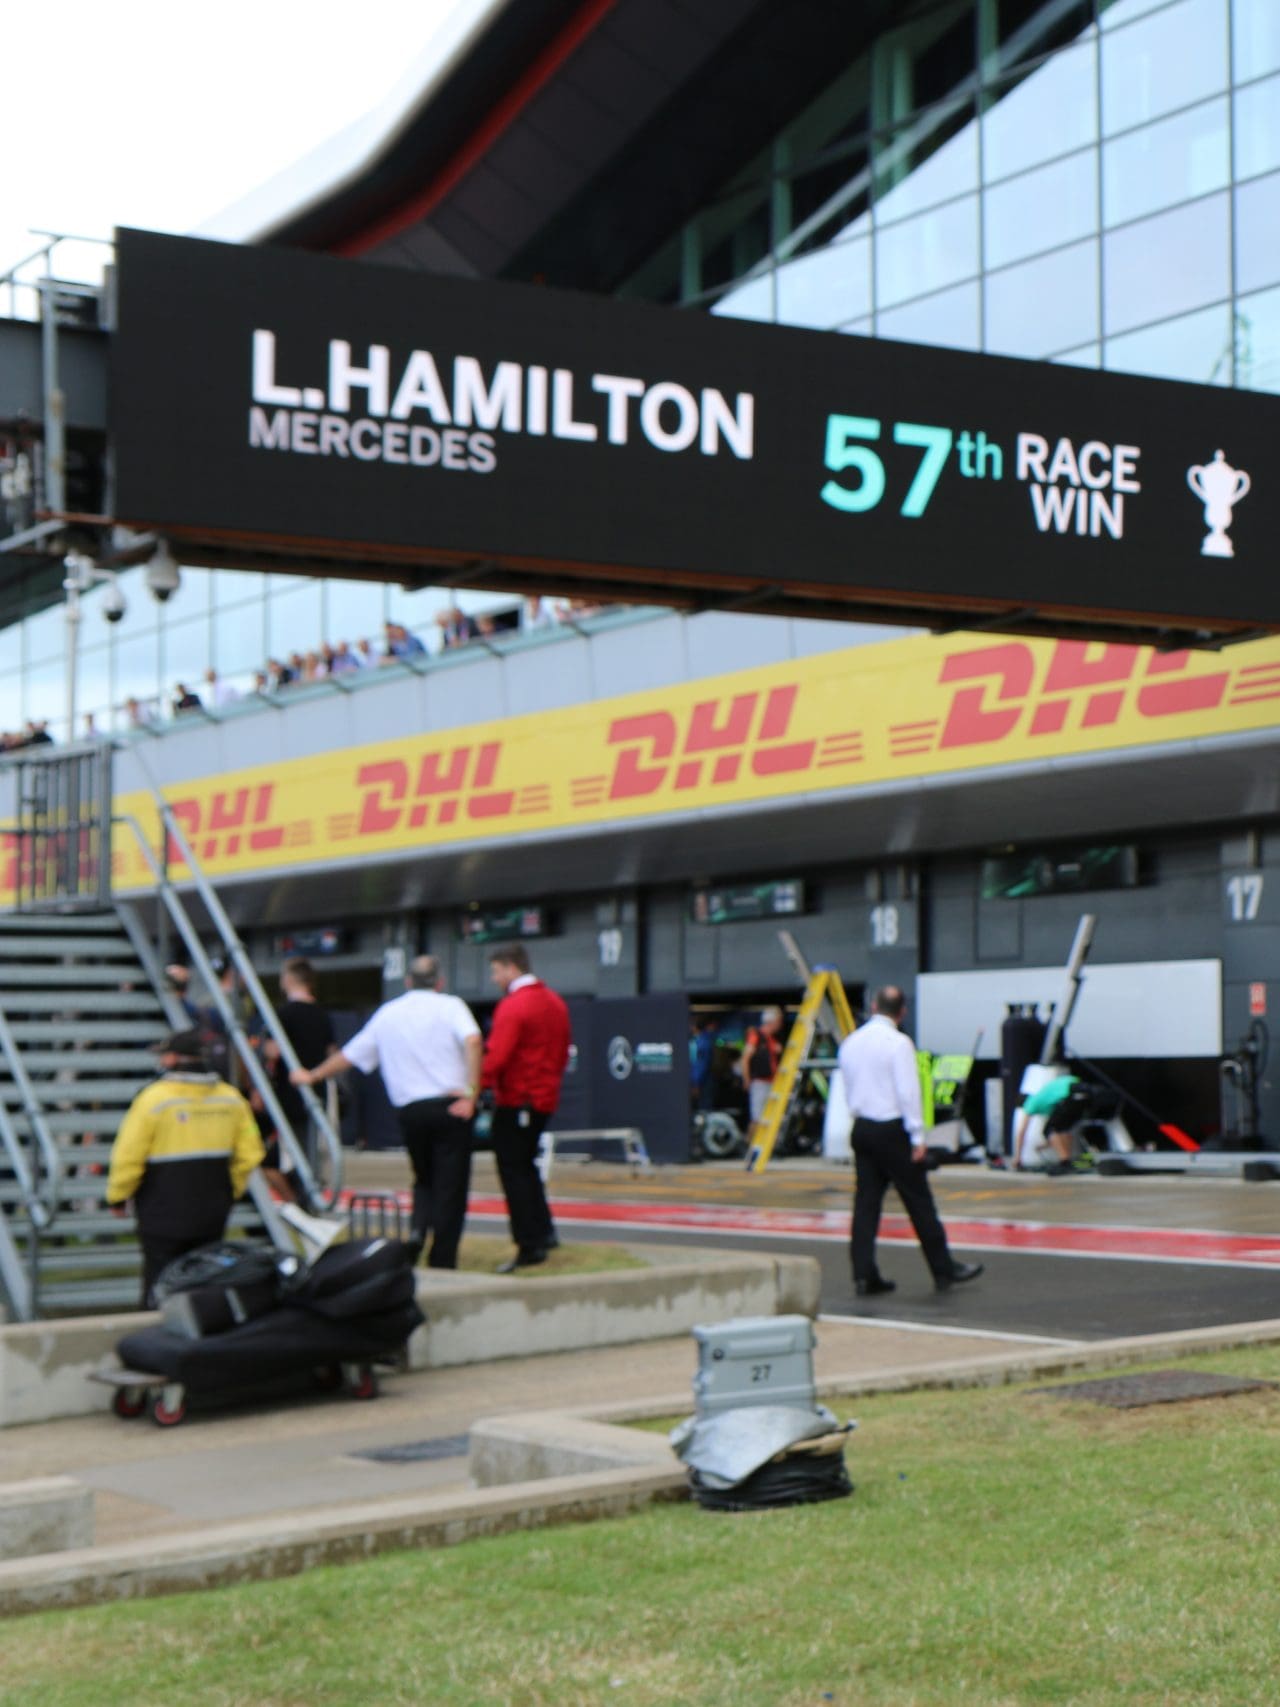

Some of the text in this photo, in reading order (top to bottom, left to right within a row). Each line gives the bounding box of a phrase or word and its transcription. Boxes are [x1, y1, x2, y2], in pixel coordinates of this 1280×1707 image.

[251, 328, 756, 460] L.HAMILTON
[248, 406, 498, 474] MERCEDES
[819, 413, 1141, 518] 57th RACE
[1030, 484, 1124, 539] WIN
[607, 684, 818, 800] DHL
[356, 741, 516, 834] DHL
[870, 905, 899, 946] 18
[1226, 874, 1264, 921] 17
[752, 1364, 772, 1383] 27
